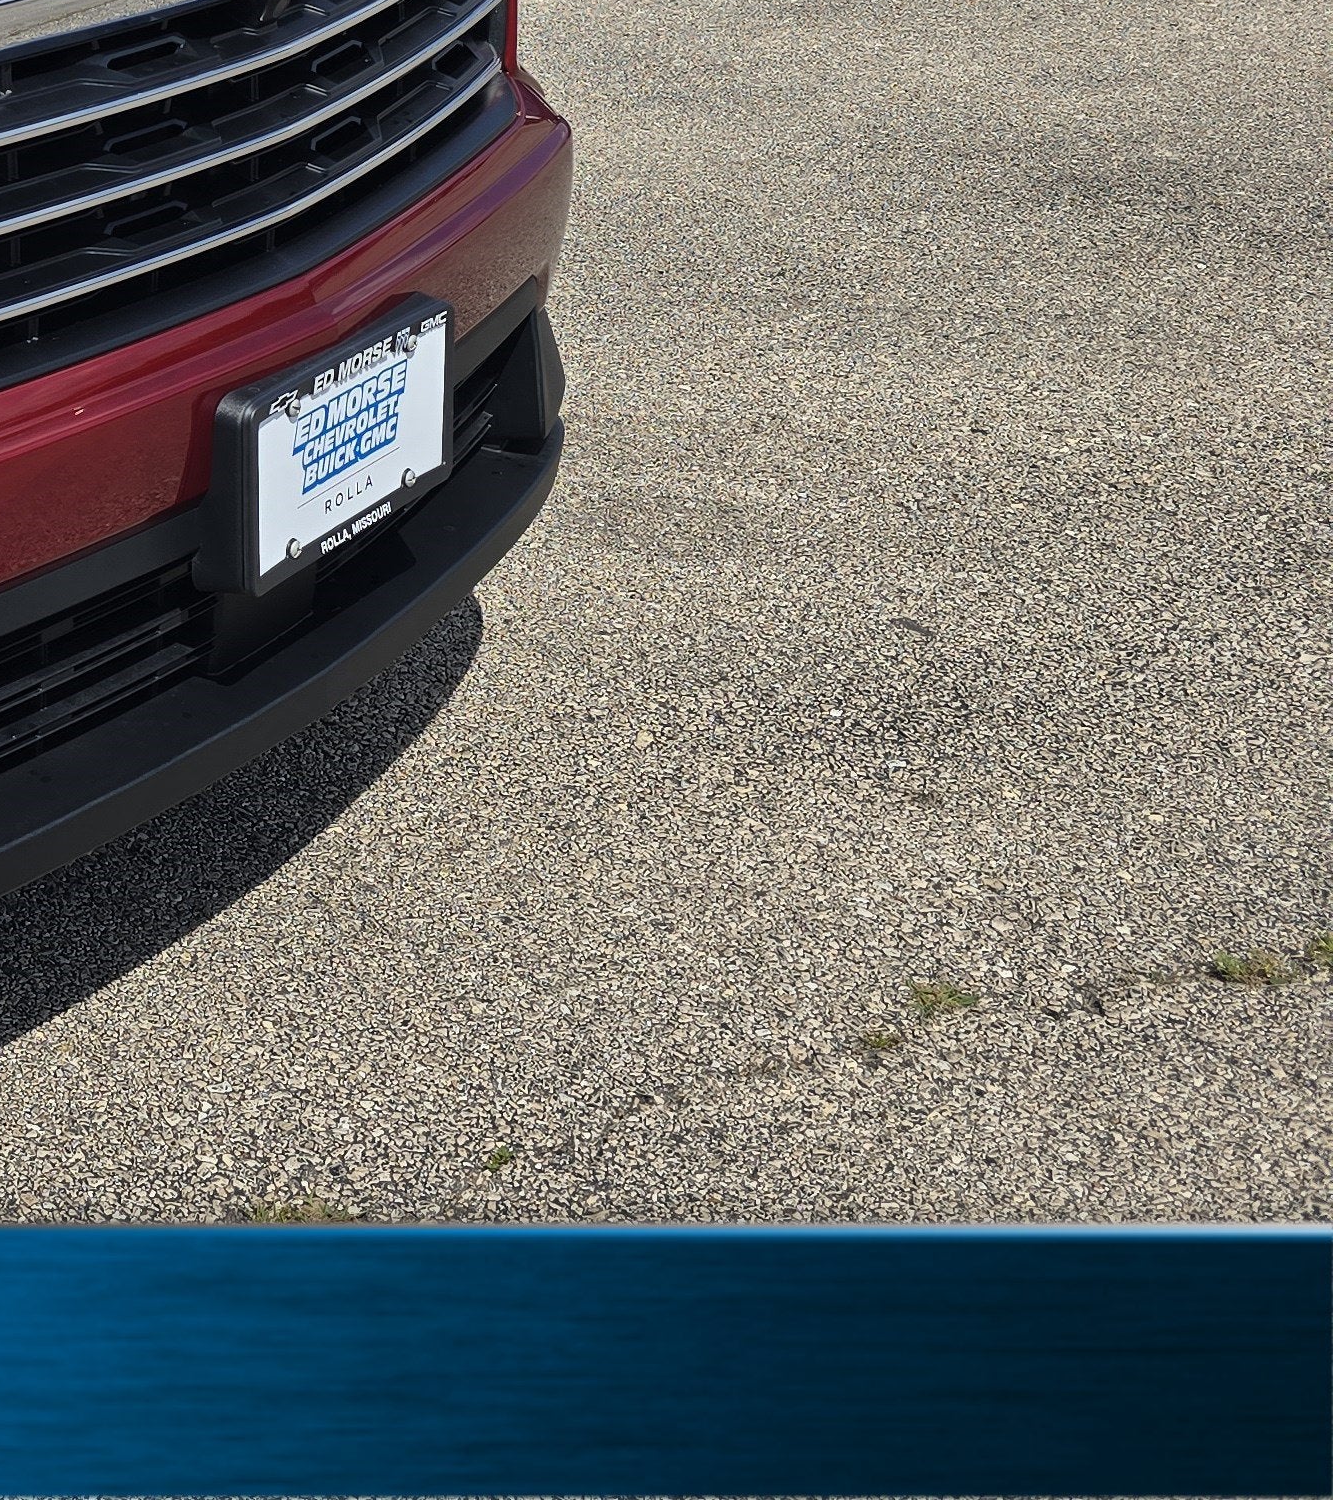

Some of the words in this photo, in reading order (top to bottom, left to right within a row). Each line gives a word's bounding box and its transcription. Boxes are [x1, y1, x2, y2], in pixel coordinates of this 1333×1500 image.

[420, 311, 448, 333] GMC
[313, 368, 335, 395] ED
[337, 336, 393, 381] MORSE
[294, 406, 326, 449] ED
[327, 363, 407, 430] MORSE
[304, 400, 397, 466] CHEVROLET
[324, 475, 373, 514] ROLLA
[320, 528, 352, 555] ROLLA,
[351, 501, 392, 535] MISSOURI
